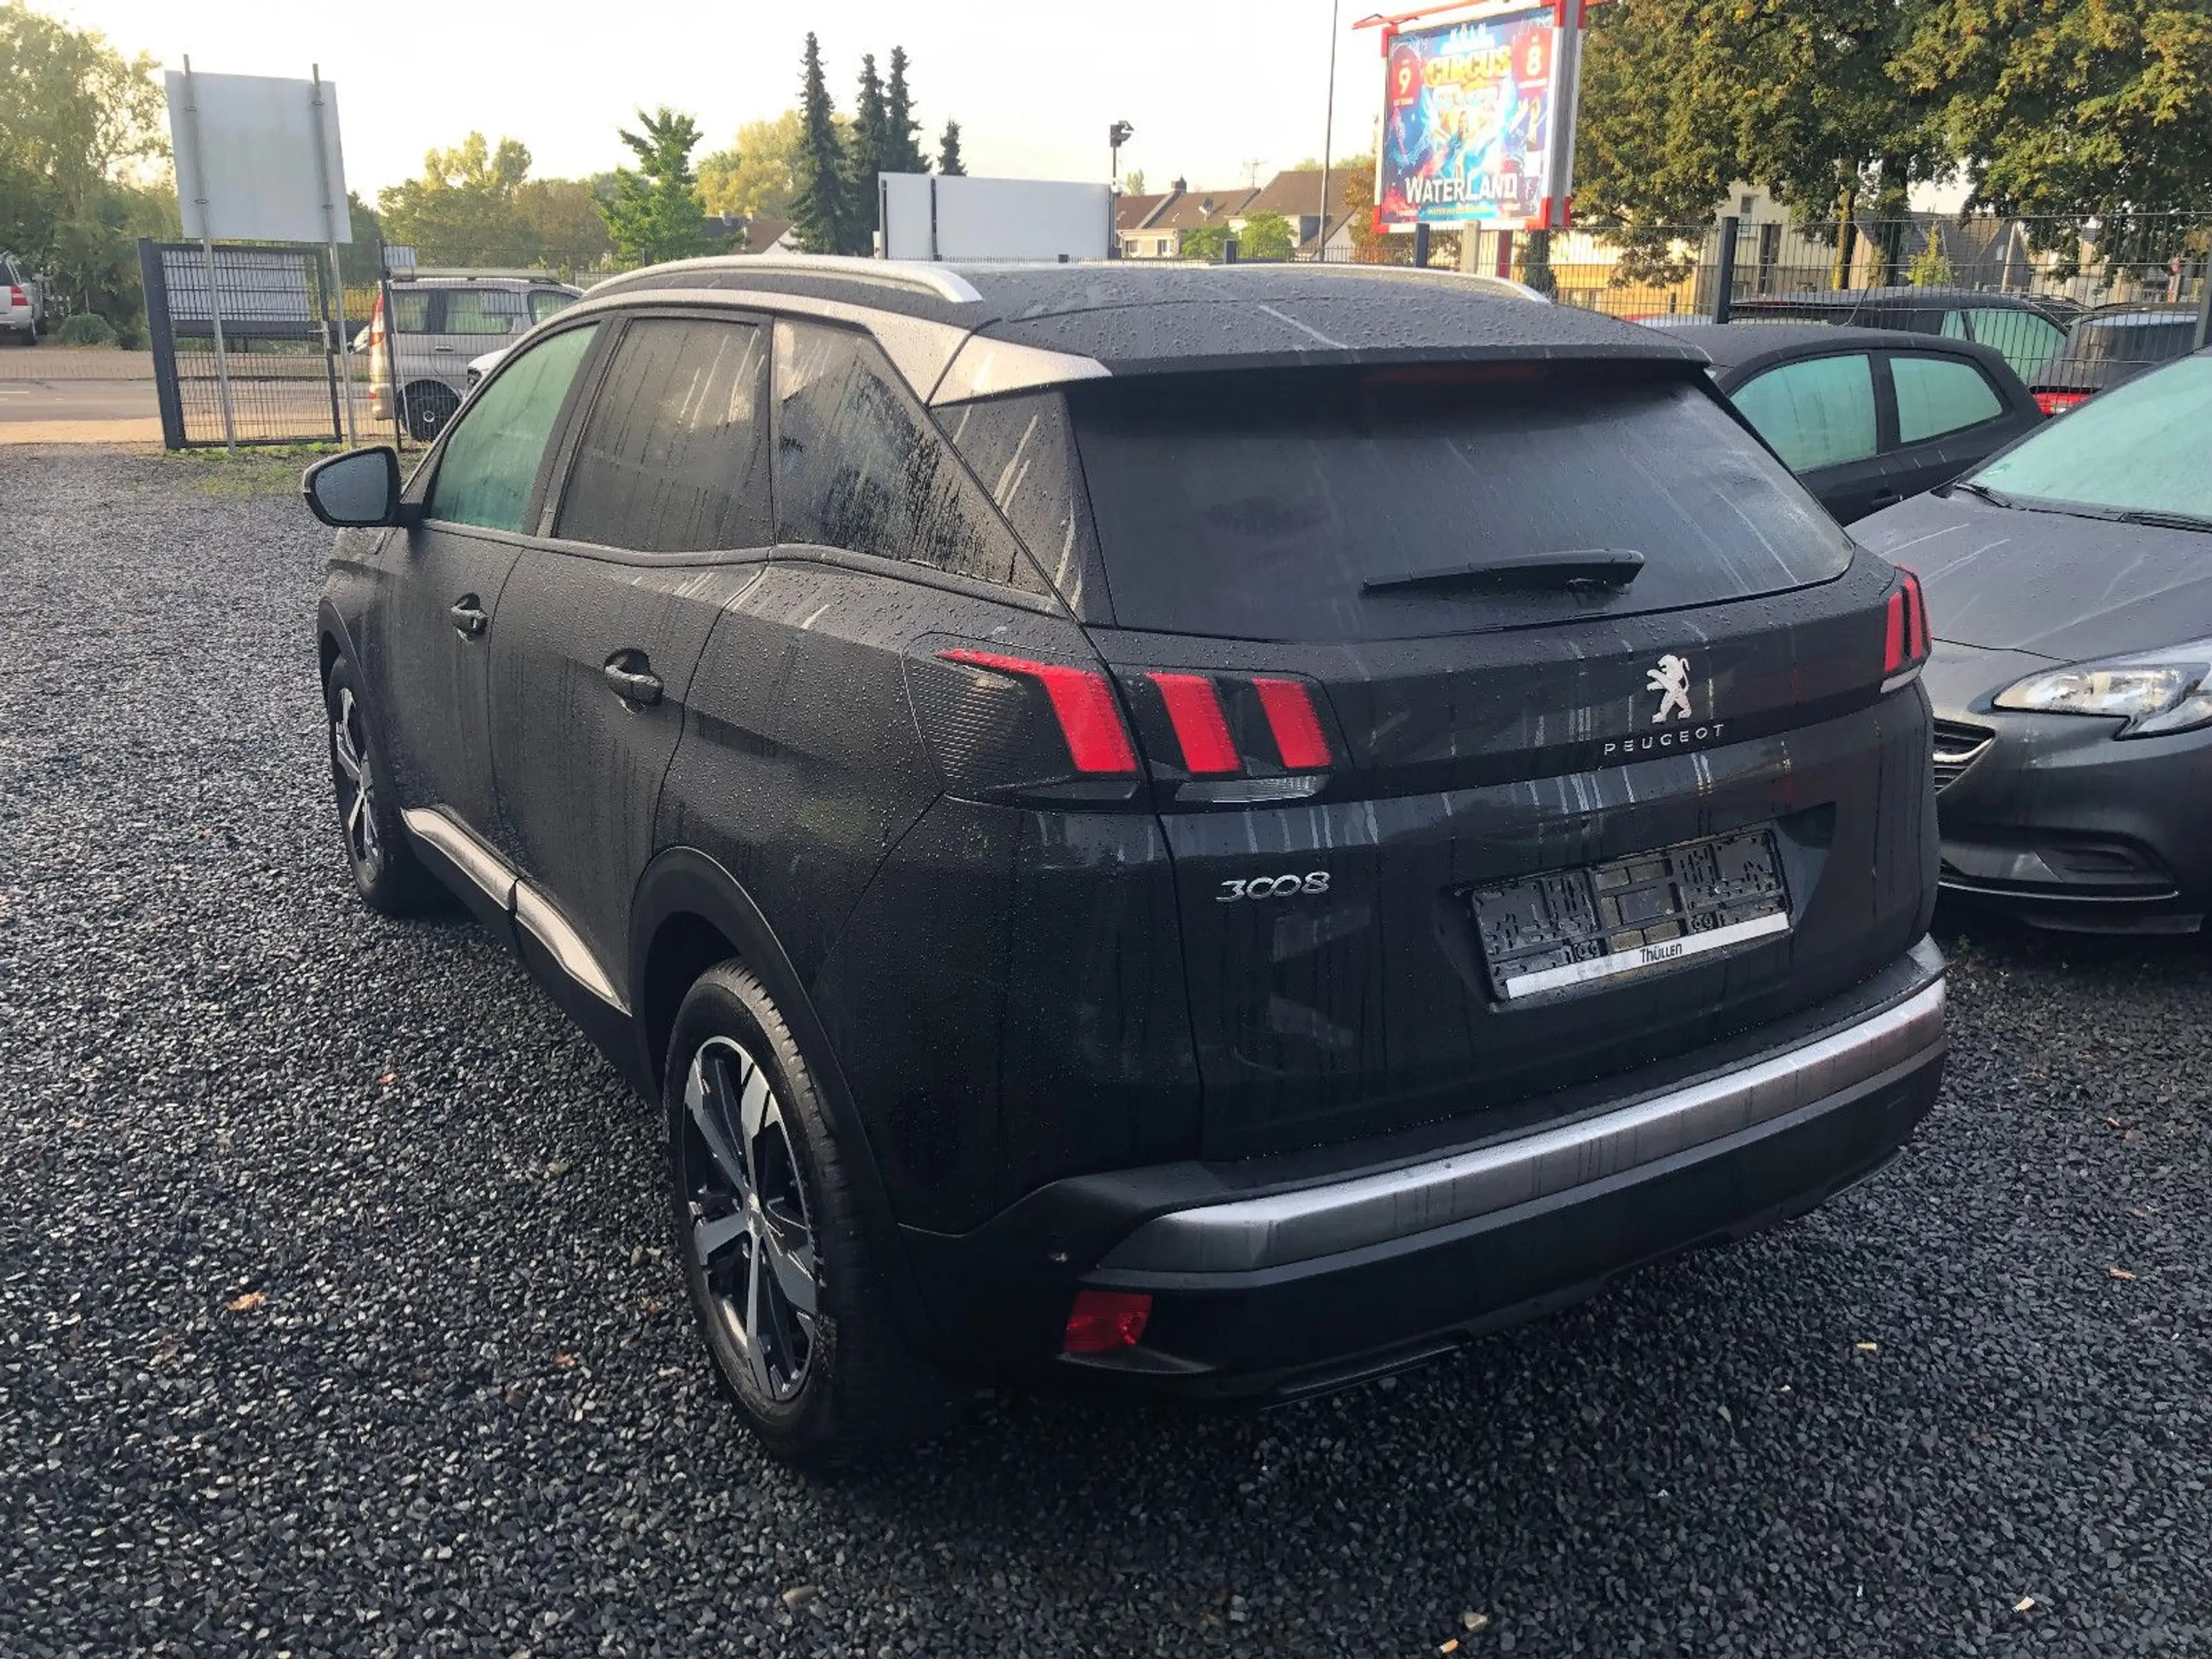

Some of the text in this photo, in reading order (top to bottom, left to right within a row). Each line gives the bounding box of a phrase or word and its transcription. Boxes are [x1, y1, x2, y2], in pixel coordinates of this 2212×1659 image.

[1423, 45, 1512, 88] CIRCUS
[1404, 173, 1518, 204] WATERLAND
[1604, 724, 1724, 756] PEUGEOT
[1215, 870, 1331, 902] 3008
